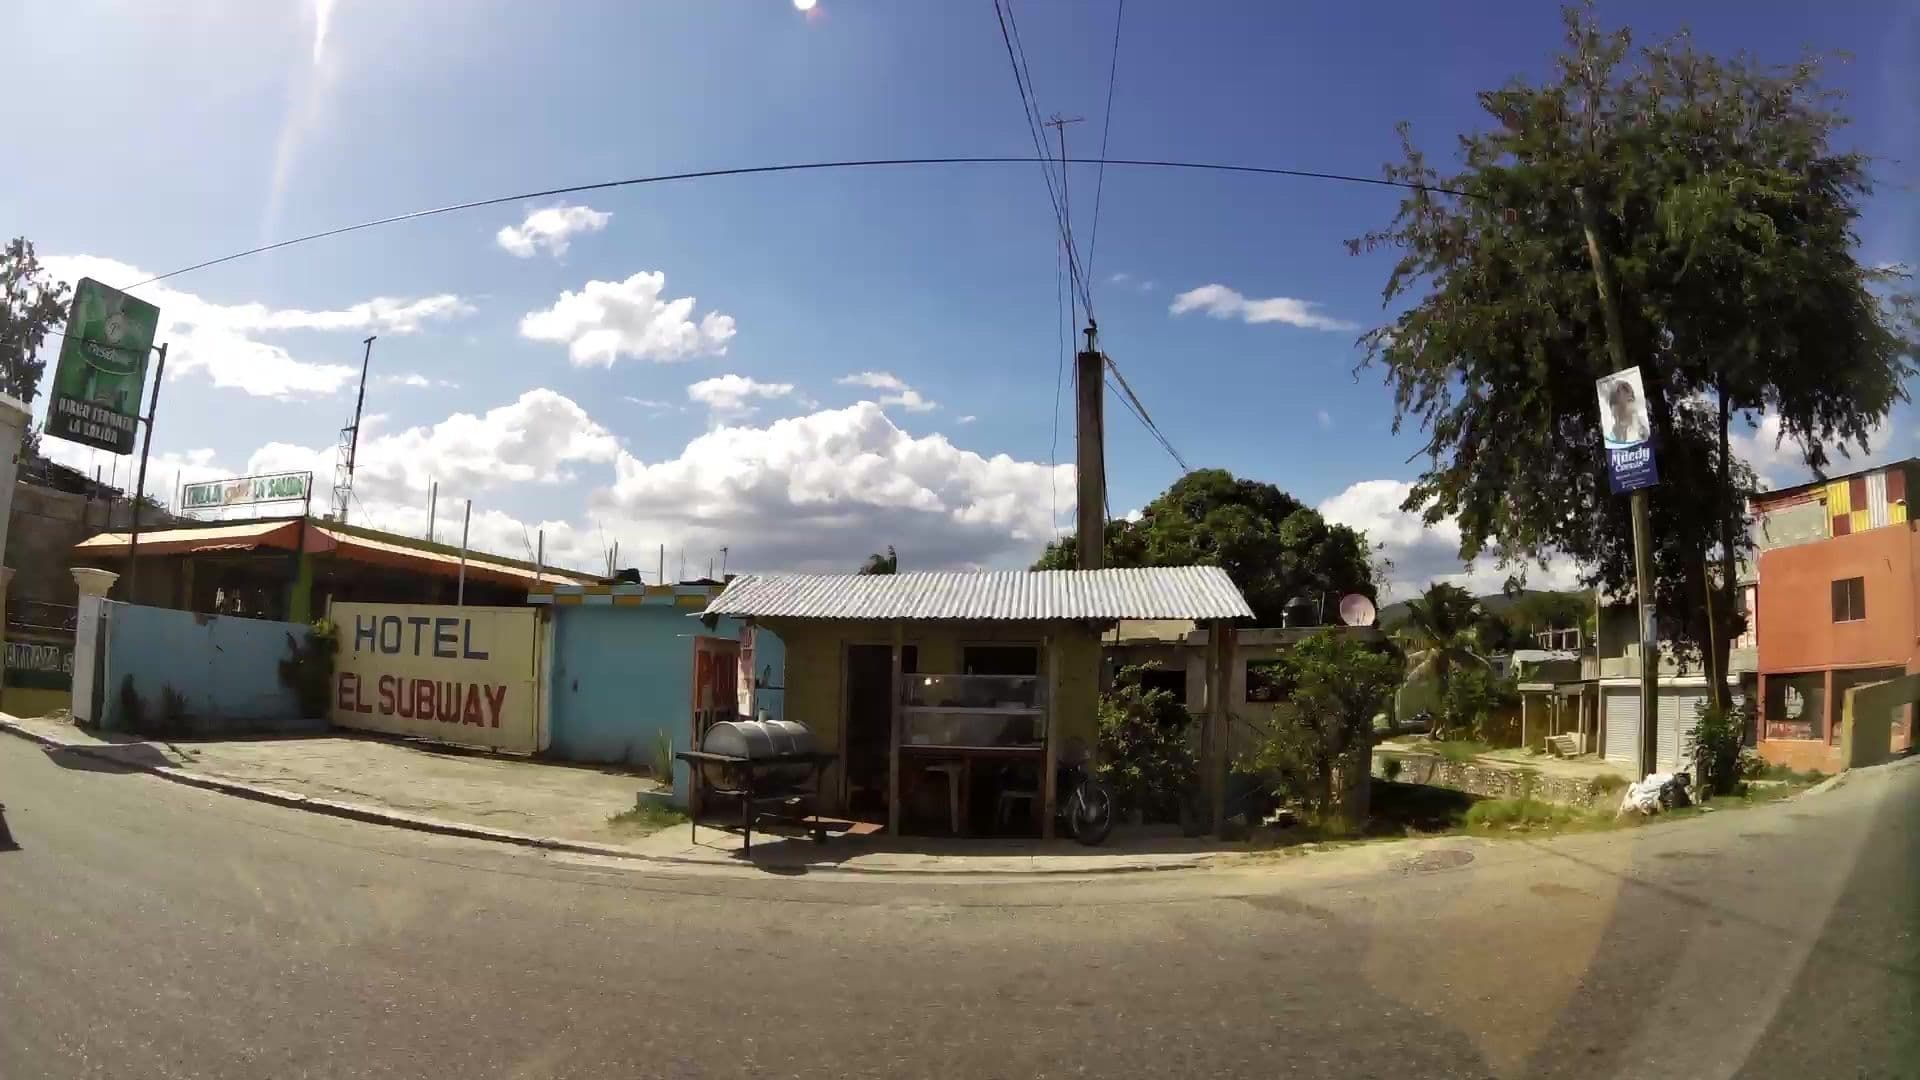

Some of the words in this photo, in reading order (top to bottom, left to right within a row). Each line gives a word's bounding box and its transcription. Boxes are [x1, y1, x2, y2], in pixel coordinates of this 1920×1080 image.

[355, 615, 489, 660] HOTEL
[339, 672, 373, 713] EL
[378, 675, 507, 728] SUBWAY
